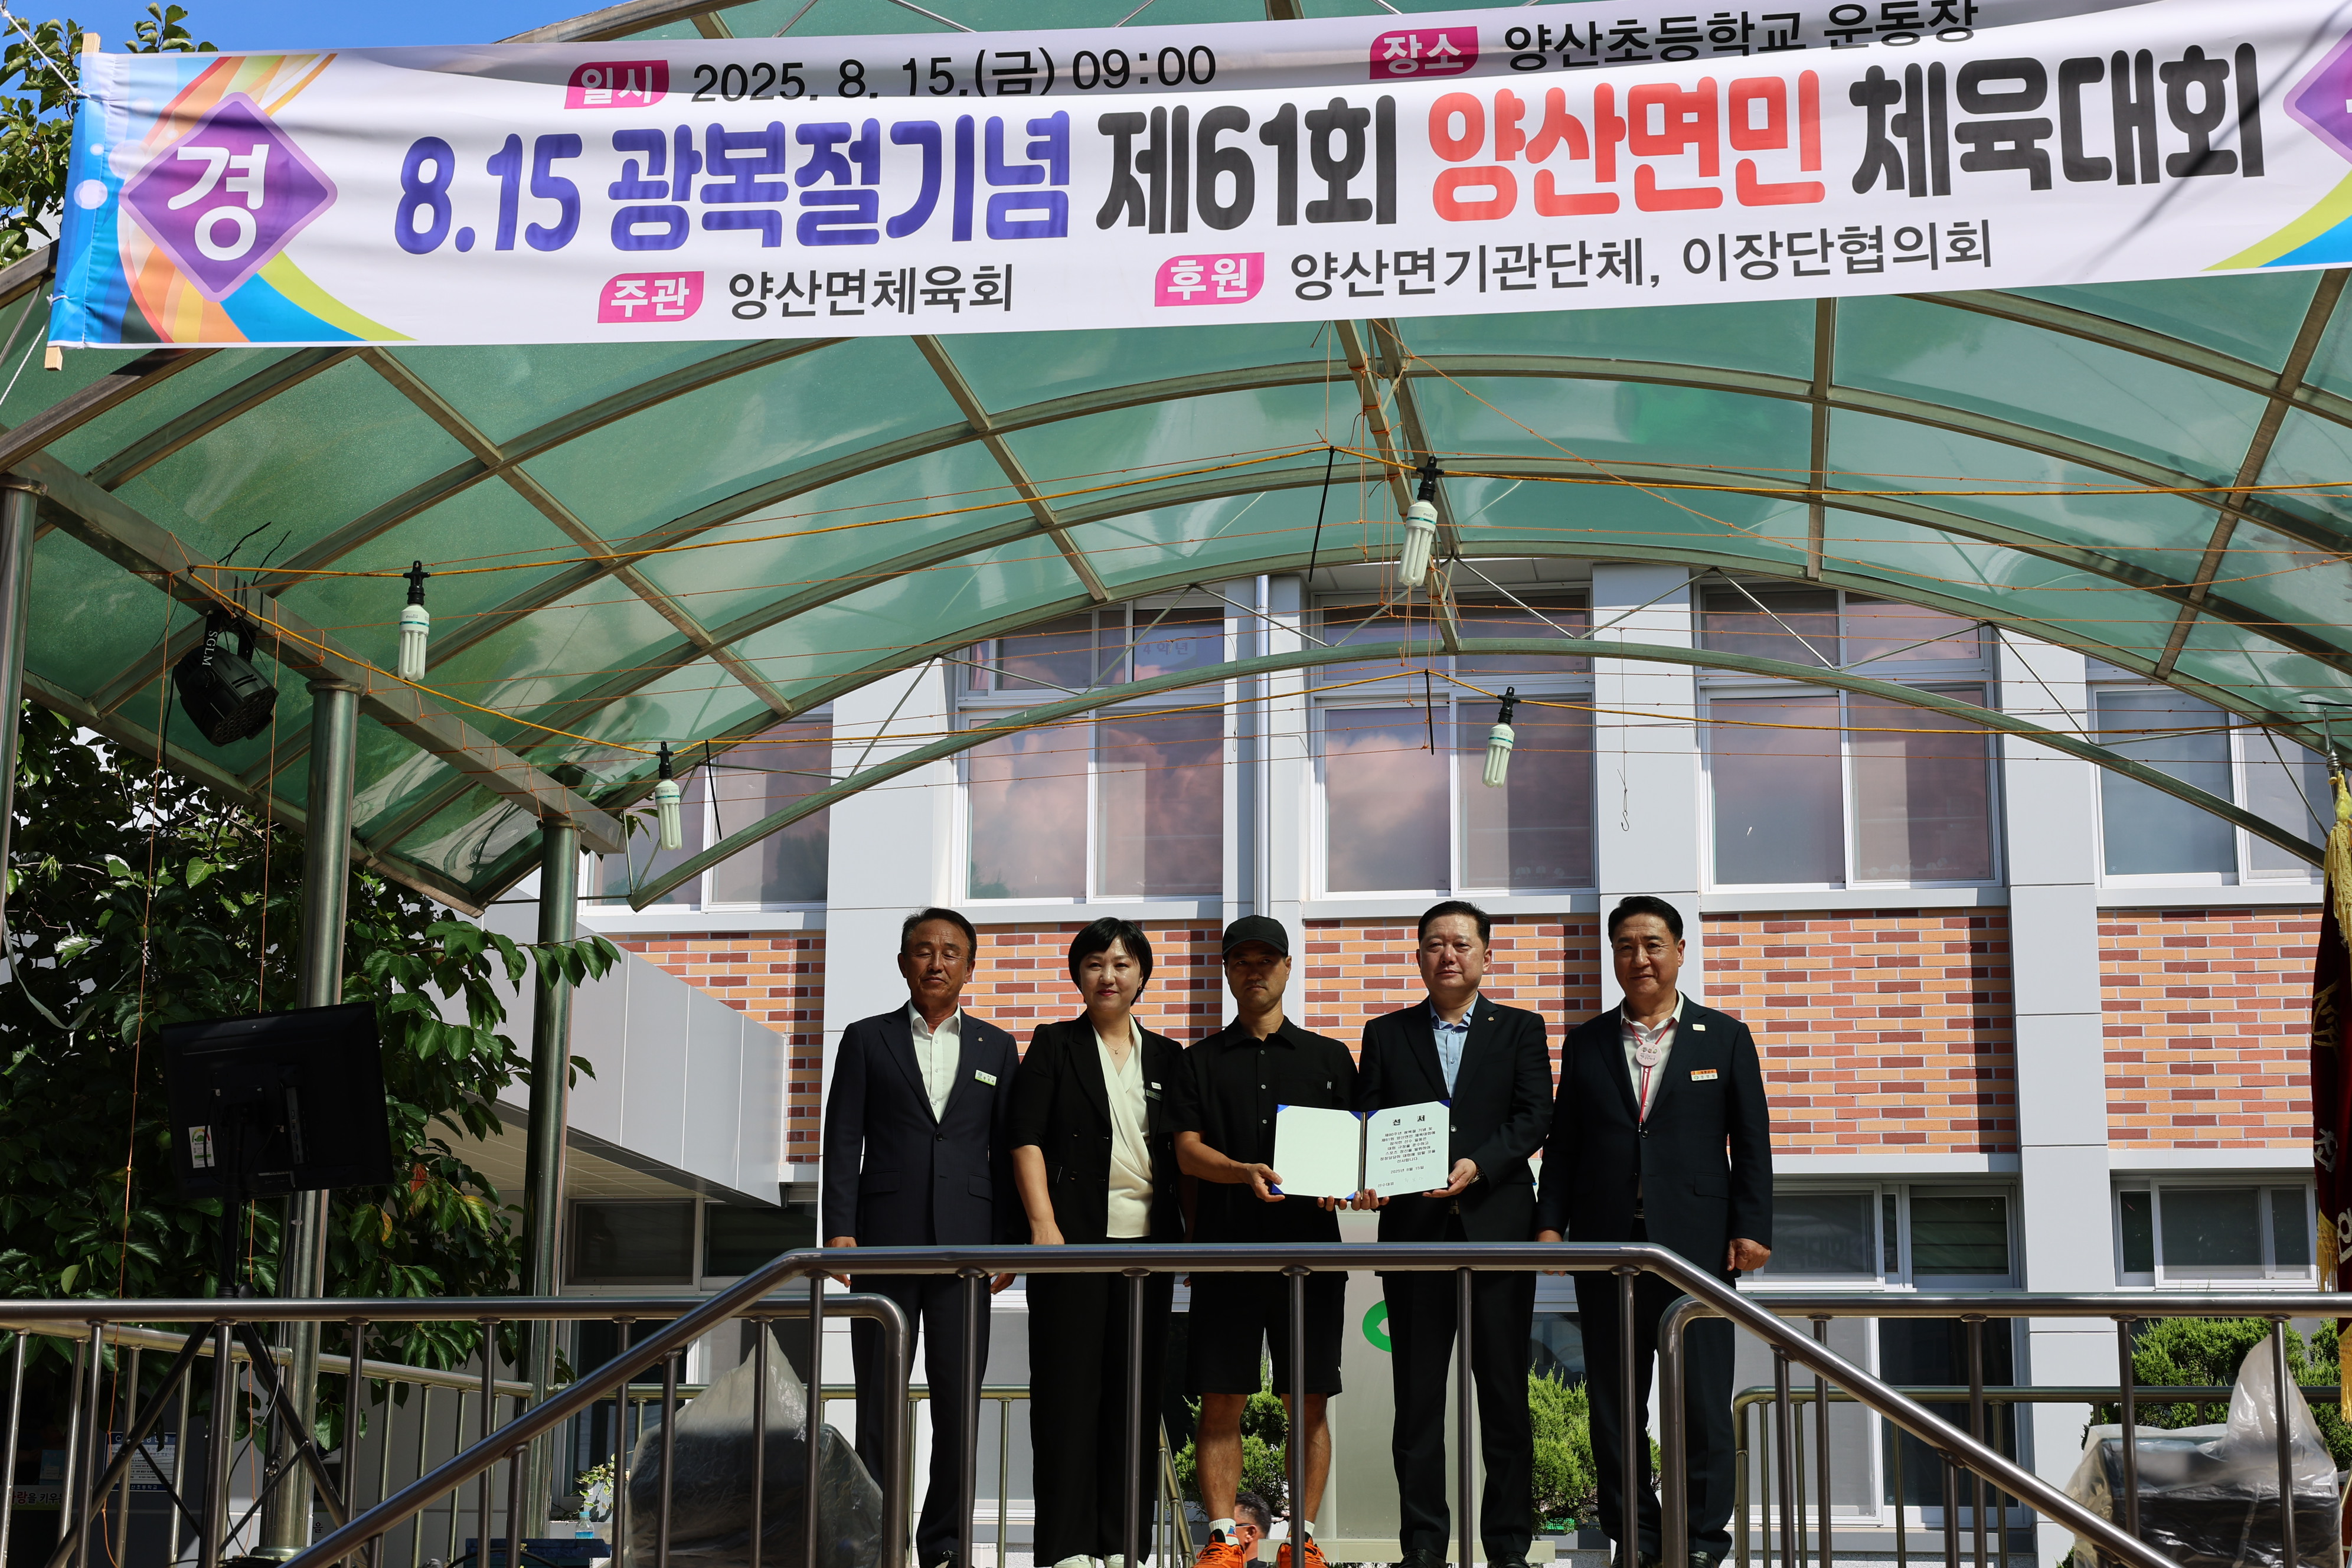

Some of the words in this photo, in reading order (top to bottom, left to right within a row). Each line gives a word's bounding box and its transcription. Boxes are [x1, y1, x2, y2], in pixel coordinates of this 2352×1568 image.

[1381, 33, 1465, 73] 장소
[1504, 13, 1807, 71] 양산초등학교
[1824, 0, 1979, 50] 운동장
[577, 66, 654, 104] 일시
[691, 62, 819, 102] 2025.
[838, 59, 879, 99] 8.
[902, 47, 1055, 97] 15.(금)
[1072, 45, 1217, 90] 09:00
[394, 133, 583, 255] 8.15
[607, 110, 1070, 251] 광복절기념
[1095, 94, 1397, 234] 제61회
[1427, 69, 1826, 223] 양산면민
[1848, 42, 2265, 198] 체육대회
[167, 143, 269, 261] 경
[610, 276, 691, 316] 주관
[729, 263, 1012, 320] 양산면체육회
[1165, 257, 1249, 302] 후원
[1290, 239, 1660, 301] 양산면기관단체,
[1682, 219, 1992, 282] 이장단협의회
[202, 631, 218, 667] SGLM
